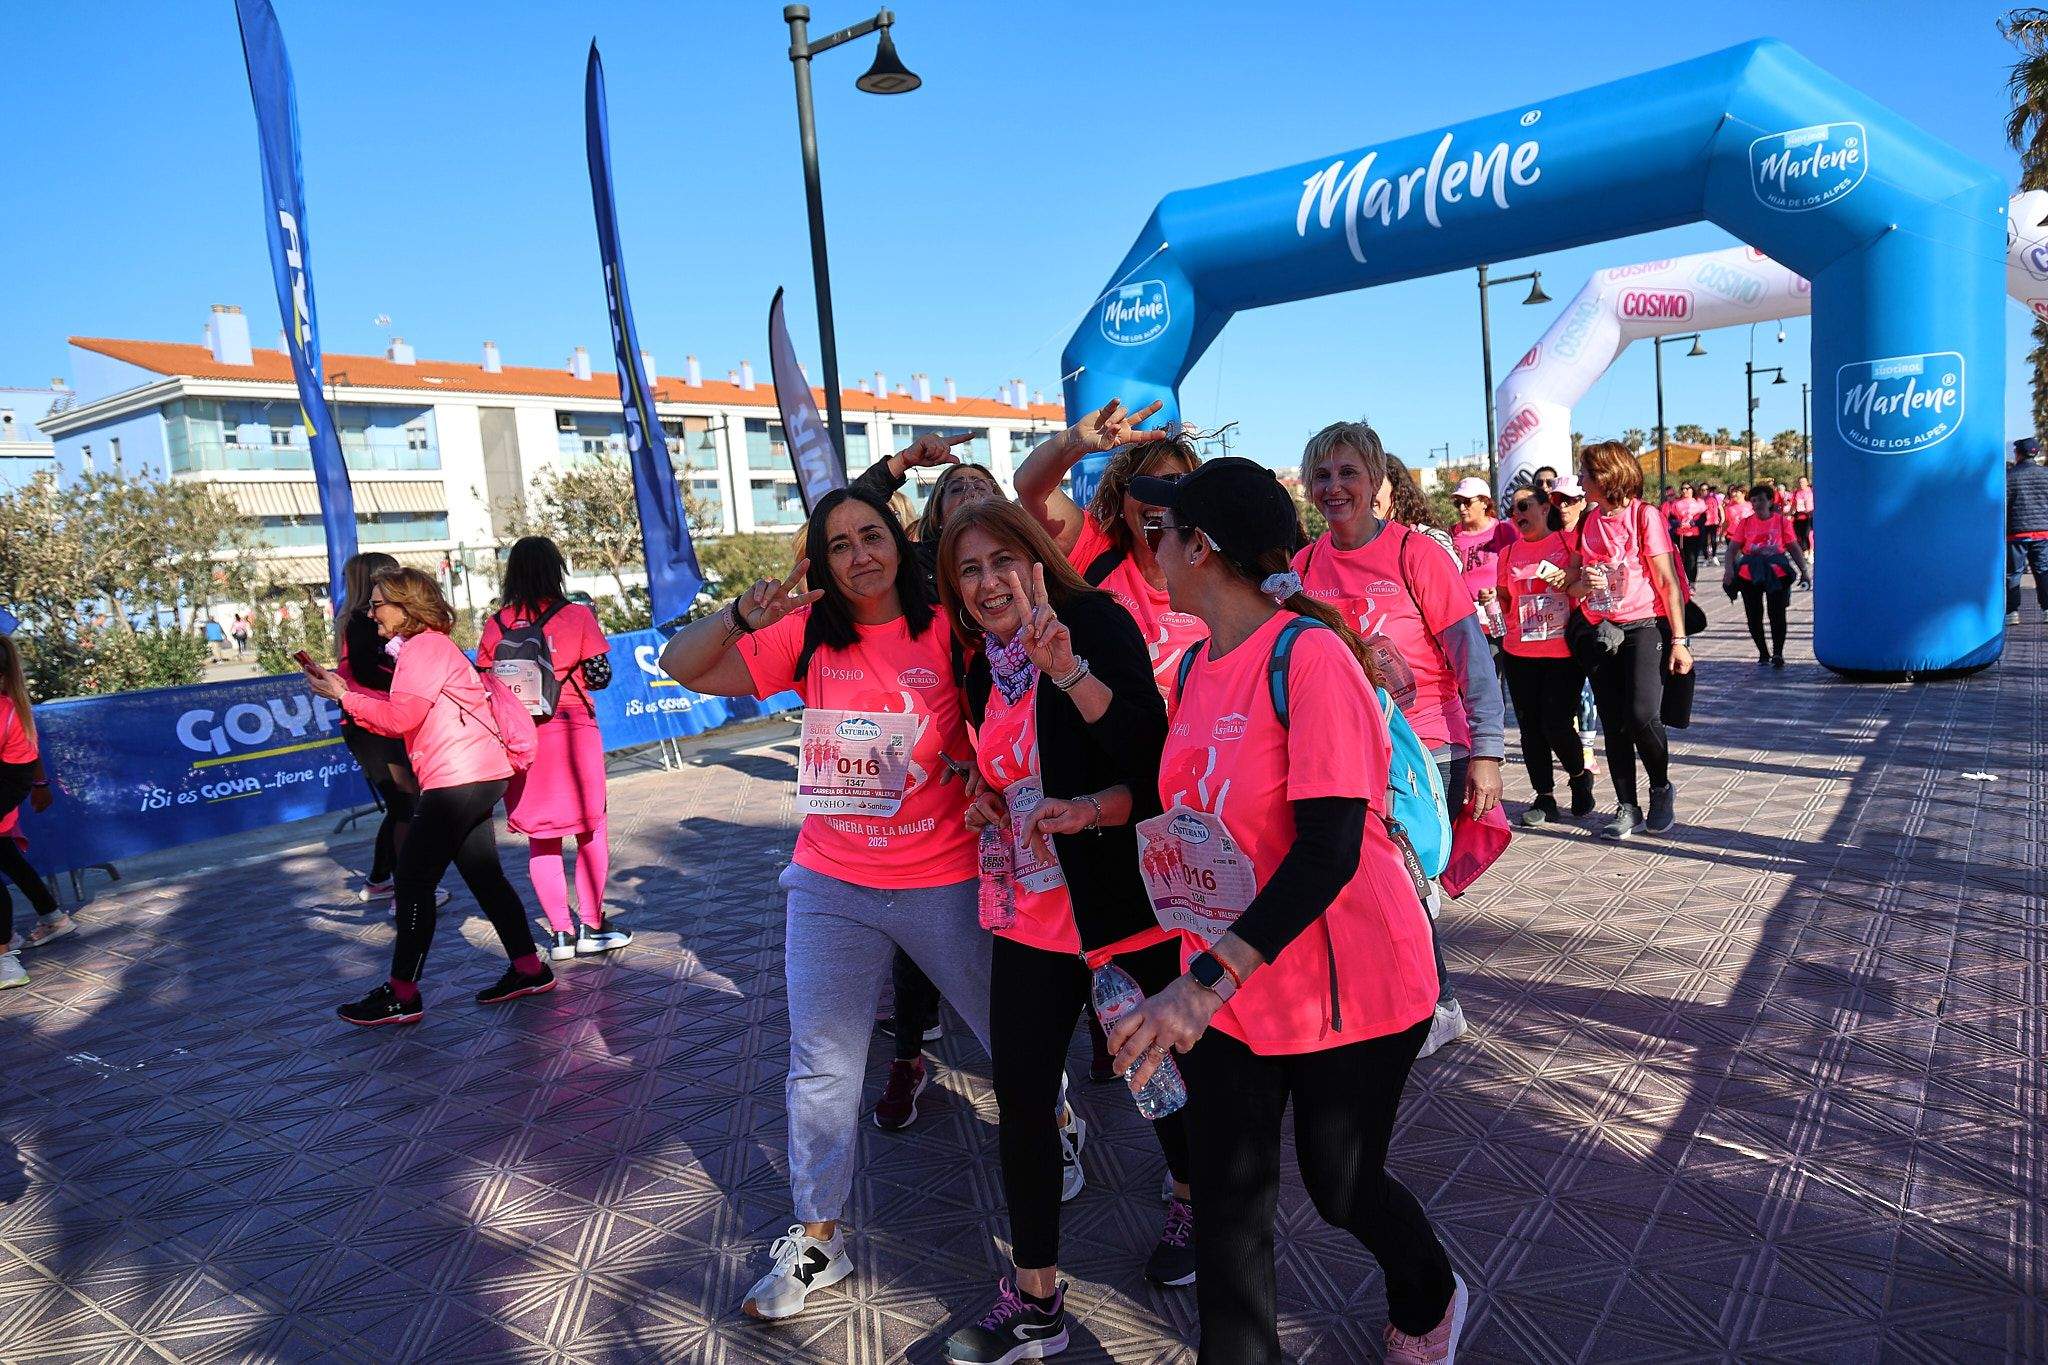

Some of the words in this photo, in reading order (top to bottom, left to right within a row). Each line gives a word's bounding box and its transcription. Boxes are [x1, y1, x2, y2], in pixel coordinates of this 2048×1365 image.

[1760, 143, 1859, 192] Marlene
[1297, 132, 1541, 263] Marlene
[1788, 198, 1800, 207] DE
[1803, 195, 1821, 206] LOS
[1823, 178, 1852, 199] ALPES
[1105, 297, 1163, 331] Marlene
[1623, 293, 1687, 318] COSMO
[1844, 377, 1956, 430] Marlene
[1849, 429, 1868, 445] HIJA
[1871, 438, 1886, 448] DE
[1889, 438, 1911, 448] LOS
[1914, 422, 1947, 445] ALPES
[1306, 588, 1340, 598] OYSHO
[821, 666, 864, 680] OYSHO
[900, 675, 936, 685] ASTURIANA
[645, 701, 658, 713] es
[658, 697, 692, 710] GOYA
[838, 726, 878, 736] ASTURIANA
[837, 758, 880, 776] 016
[177, 790, 198, 804] es
[201, 777, 261, 799] GOYA
[319, 762, 348, 787] que
[845, 779, 866, 787] 1347
[810, 799, 845, 809] OYSHO
[824, 815, 864, 835] CARRERA
[866, 825, 880, 836] DE
[882, 826, 896, 836] LA
[899, 818, 935, 836] MUJER
[868, 837, 888, 847] 2025
[1182, 863, 1217, 891] 016
